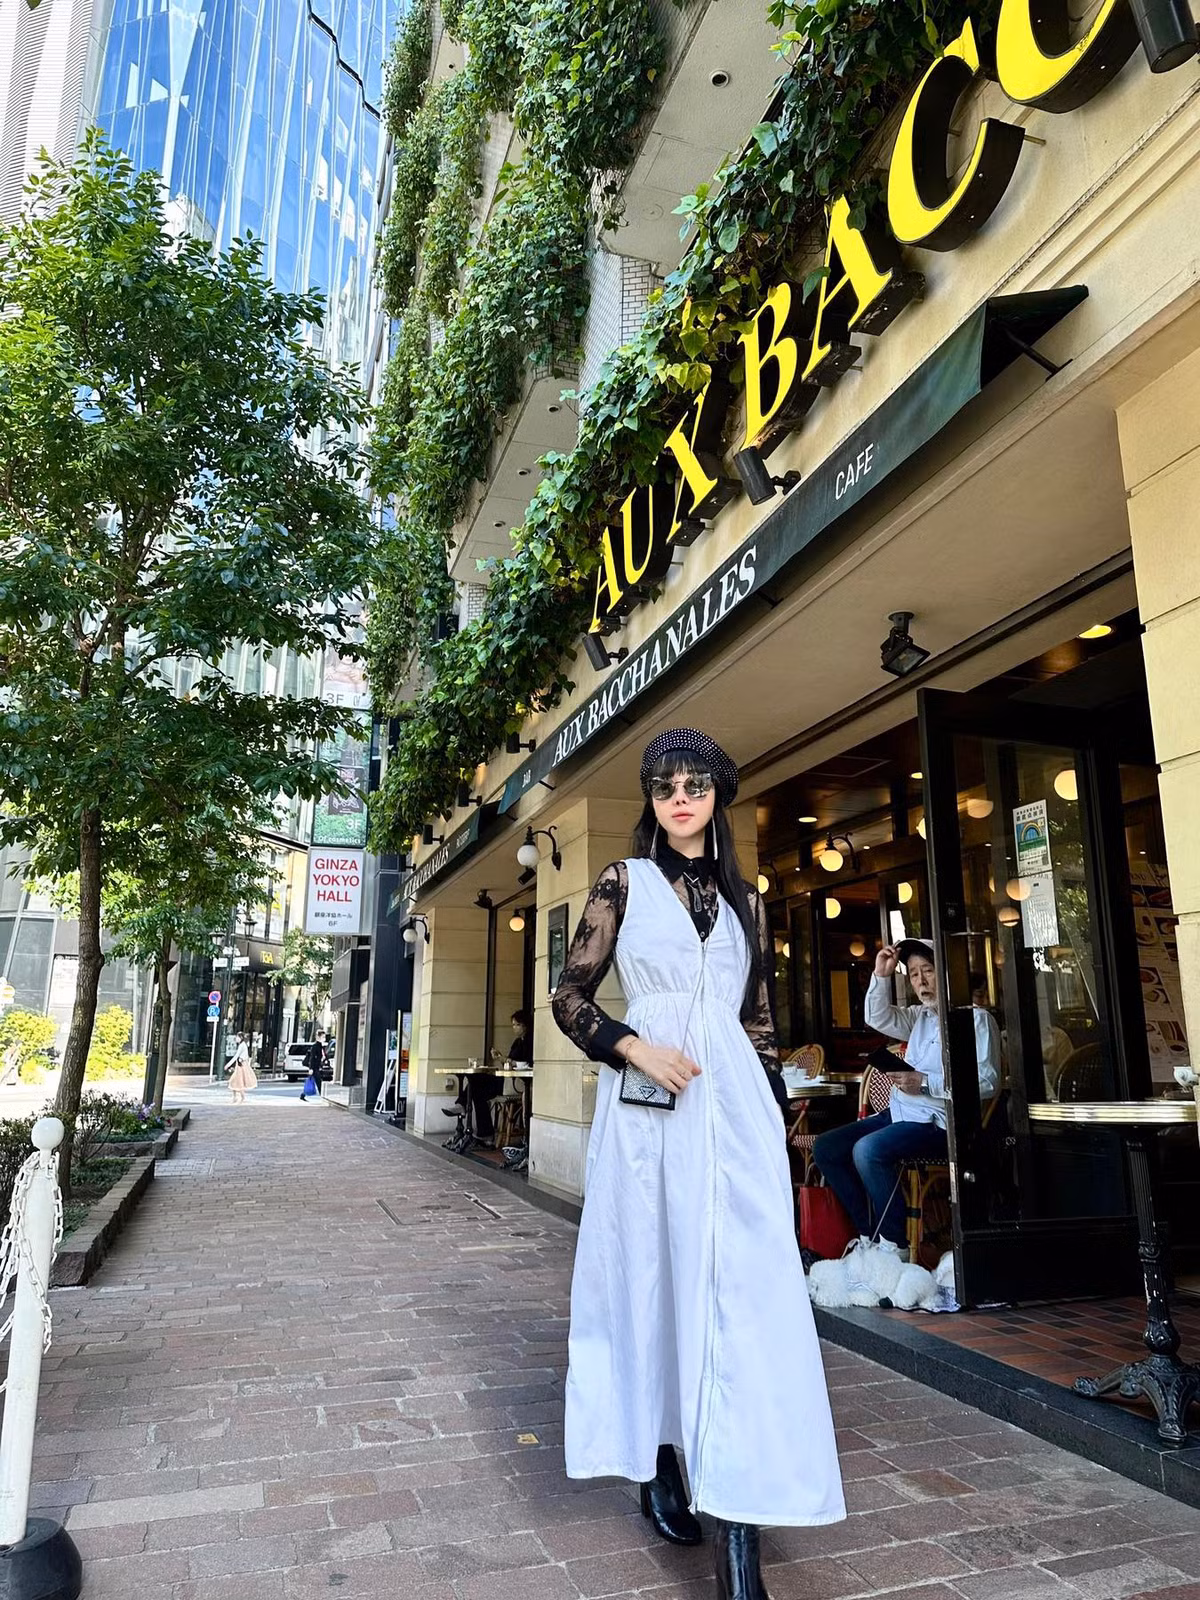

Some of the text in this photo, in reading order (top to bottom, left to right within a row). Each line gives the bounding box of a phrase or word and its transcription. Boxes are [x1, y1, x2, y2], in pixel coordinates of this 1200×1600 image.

[835, 442, 876, 501] CAFE
[589, 382, 717, 633] AUX
[552, 545, 757, 767] AUX BACCHANALES
[326, 692, 344, 704] 3F
[315, 858, 358, 871] GINZA
[313, 874, 360, 887] YOKYO
[317, 890, 352, 902] HALL
